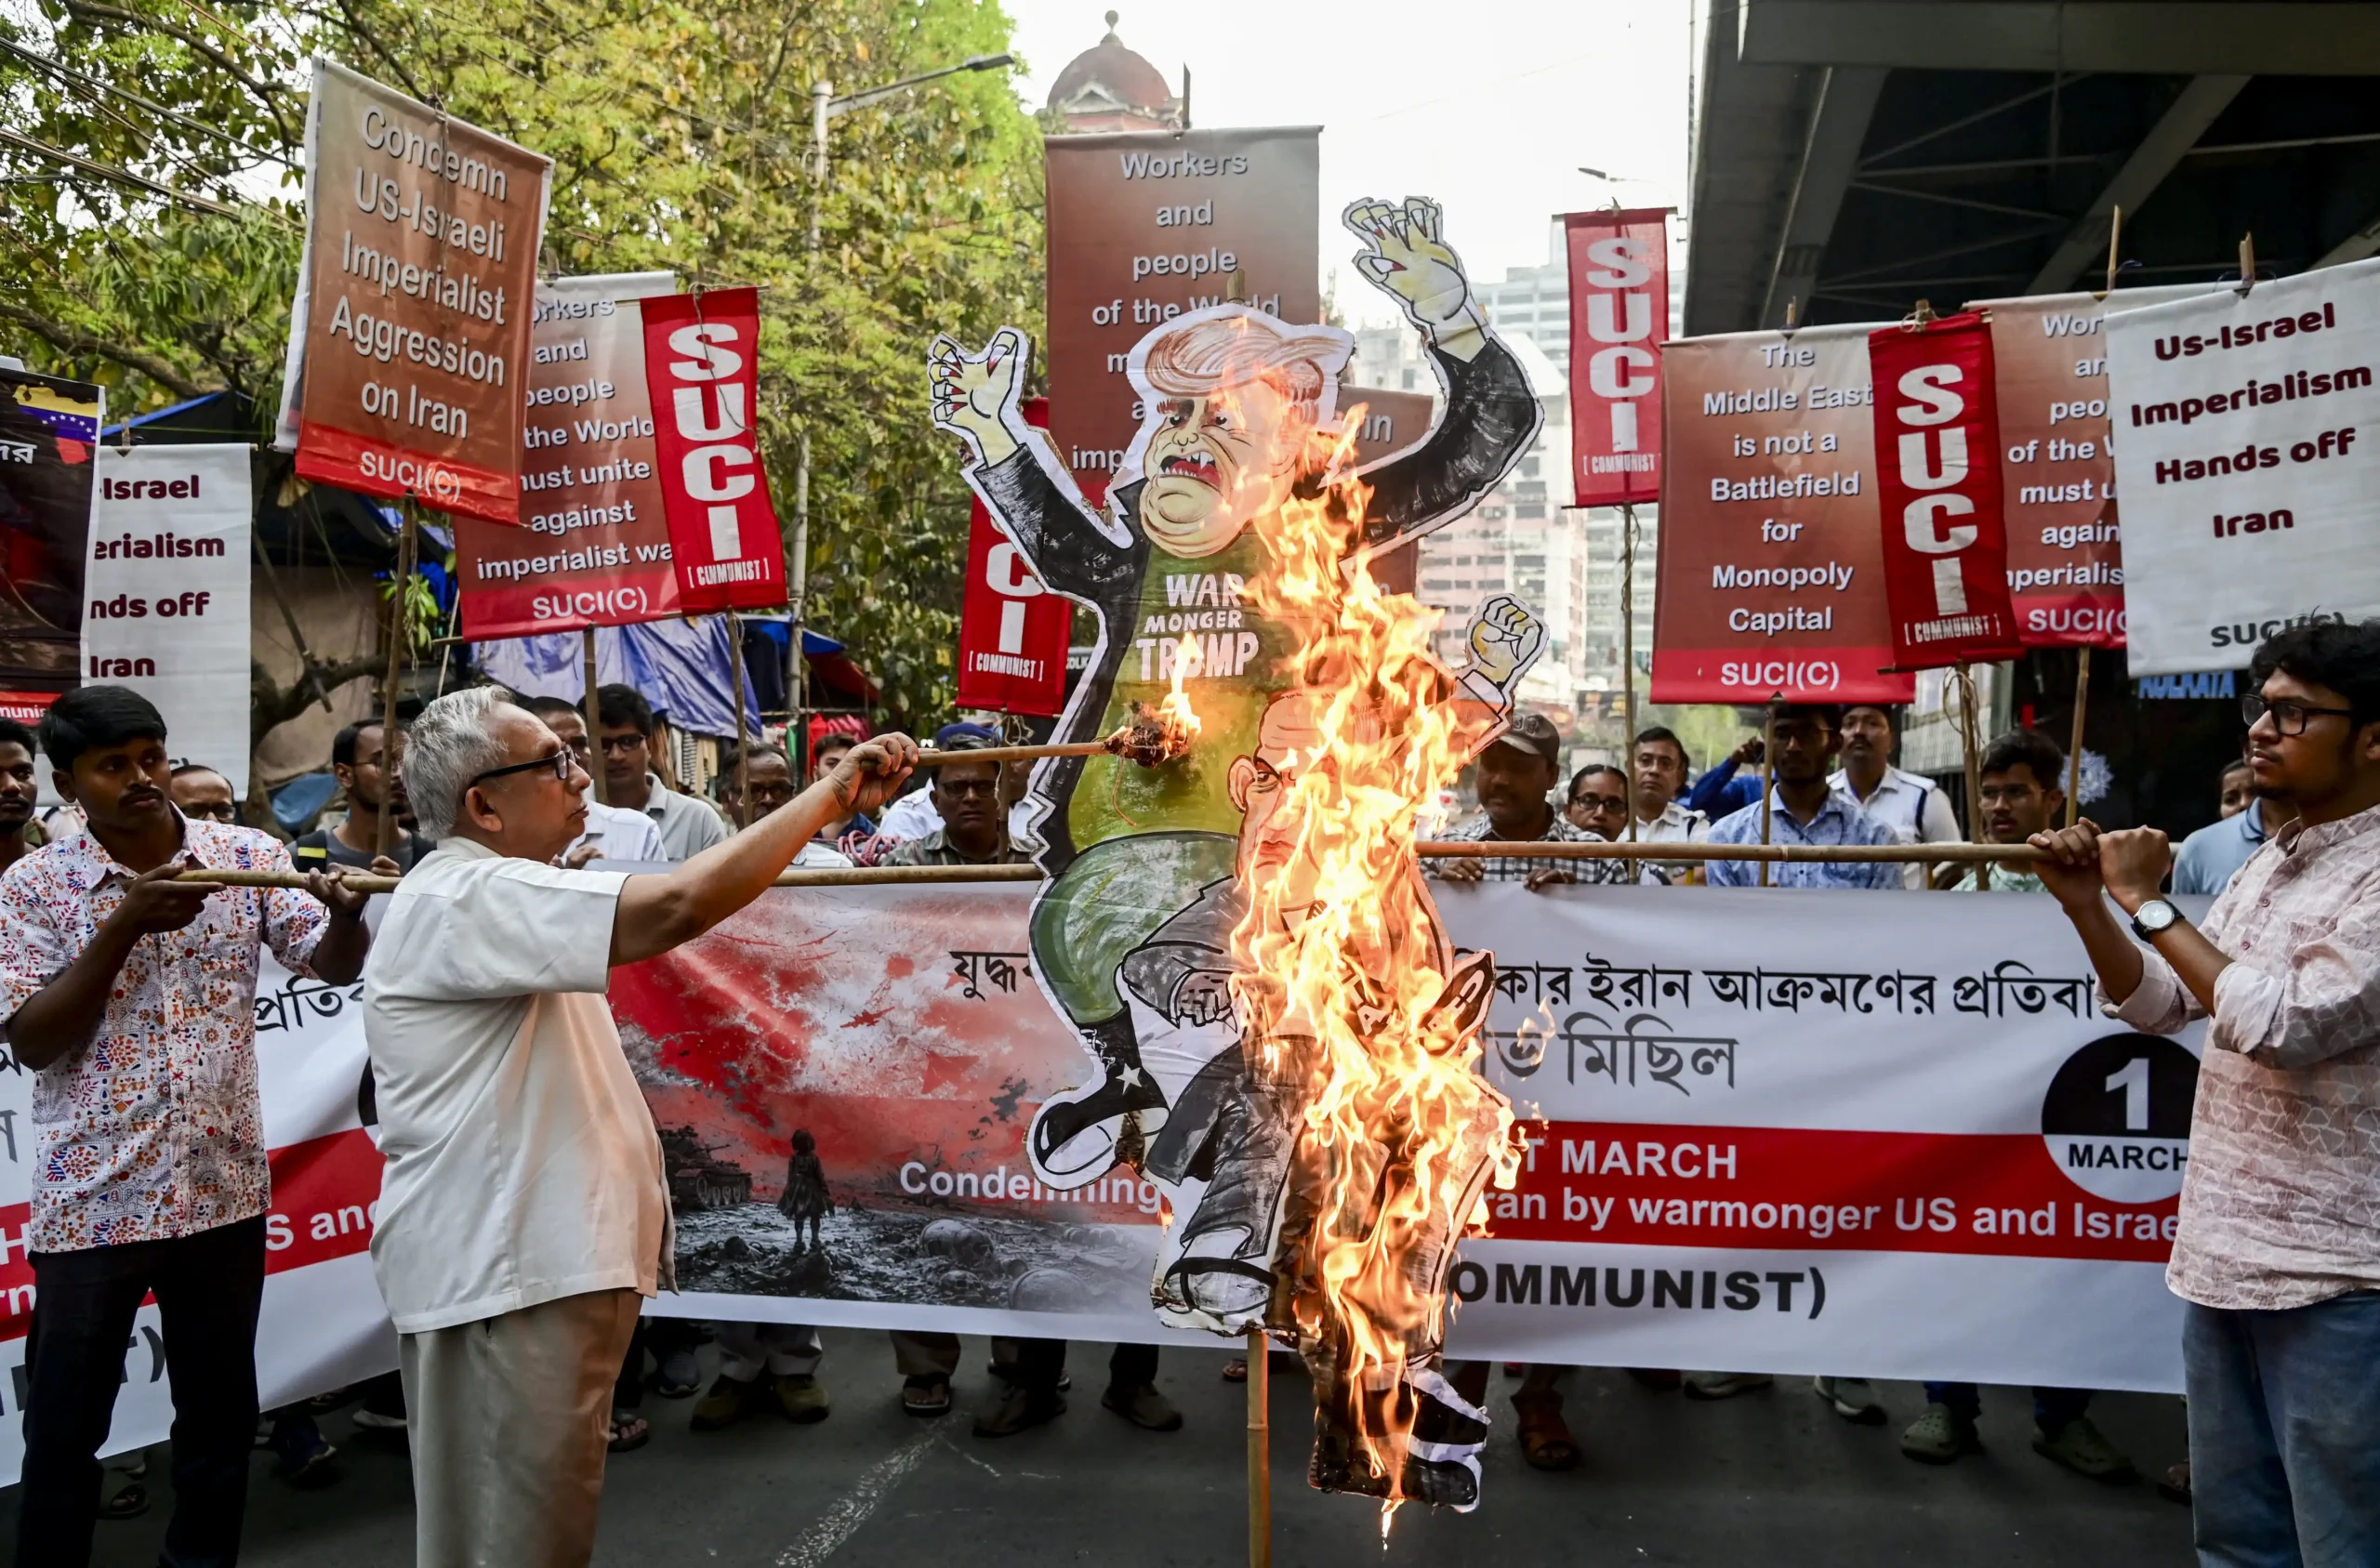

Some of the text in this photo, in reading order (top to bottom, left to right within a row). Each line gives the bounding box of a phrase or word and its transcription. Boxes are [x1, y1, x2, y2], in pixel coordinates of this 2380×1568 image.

[361, 104, 508, 202] Condemn
[1120, 152, 1248, 179] Workers
[354, 166, 504, 263] US-Israeli
[1156, 200, 1213, 228] and
[343, 230, 505, 326] Imperialist
[1133, 248, 1237, 282] people
[533, 296, 615, 323] orkers
[1091, 298, 1122, 325] of
[1132, 297, 1181, 323] the
[329, 295, 505, 388] Aggression
[1586, 237, 1655, 452] SUCI
[2154, 302, 2335, 362] Us-Israel
[536, 337, 588, 364] and
[1761, 344, 1815, 368] The
[361, 381, 469, 440] on Iran
[1703, 385, 1874, 416] Middle East
[2131, 366, 2372, 427] Imperialism
[524, 426, 568, 448] the
[668, 323, 756, 562] SUCI
[1734, 430, 1838, 457] is not a
[2008, 440, 2039, 463] of
[2047, 438, 2096, 462] the
[580, 458, 651, 484] unite
[2155, 444, 2281, 484] Hands
[2290, 428, 2356, 463] off
[360, 451, 462, 503] SUCI(C)
[1711, 471, 1860, 502] Battlefield
[1897, 363, 1979, 616] SUCI
[2020, 479, 2094, 504] must
[531, 499, 637, 536] against
[1761, 519, 1804, 543] for
[2214, 508, 2294, 538] Iran
[94, 533, 225, 560] erialism
[2041, 520, 2121, 549] again
[477, 542, 673, 581] imperialist wa
[1712, 561, 1855, 591] Monopoly
[90, 591, 210, 619] nds off
[532, 586, 648, 620] SUCI(C)
[1166, 573, 1244, 607] WAR
[1144, 610, 1242, 634] MONGER
[1729, 606, 1832, 637] Capital
[90, 655, 155, 679] Iran
[1720, 661, 1840, 691] SUCI(C)
[1582, 952, 1692, 1012] ইরান
[1701, 966, 1937, 1015] আক্রমণের
[1953, 960, 2096, 1021] প্রতিবা
[1558, 1011, 1739, 1097] মিছিল
[2105, 1058, 2150, 1131] 1
[1561, 1139, 1737, 1179] MARCH
[1563, 1187, 1615, 1231] by
[1628, 1197, 1881, 1239] warmonger
[1895, 1197, 1957, 1232] US
[1972, 1201, 2056, 1236] and
[2074, 1203, 2179, 1242] Israe
[1448, 1260, 1827, 1320] OMMUNIST)
